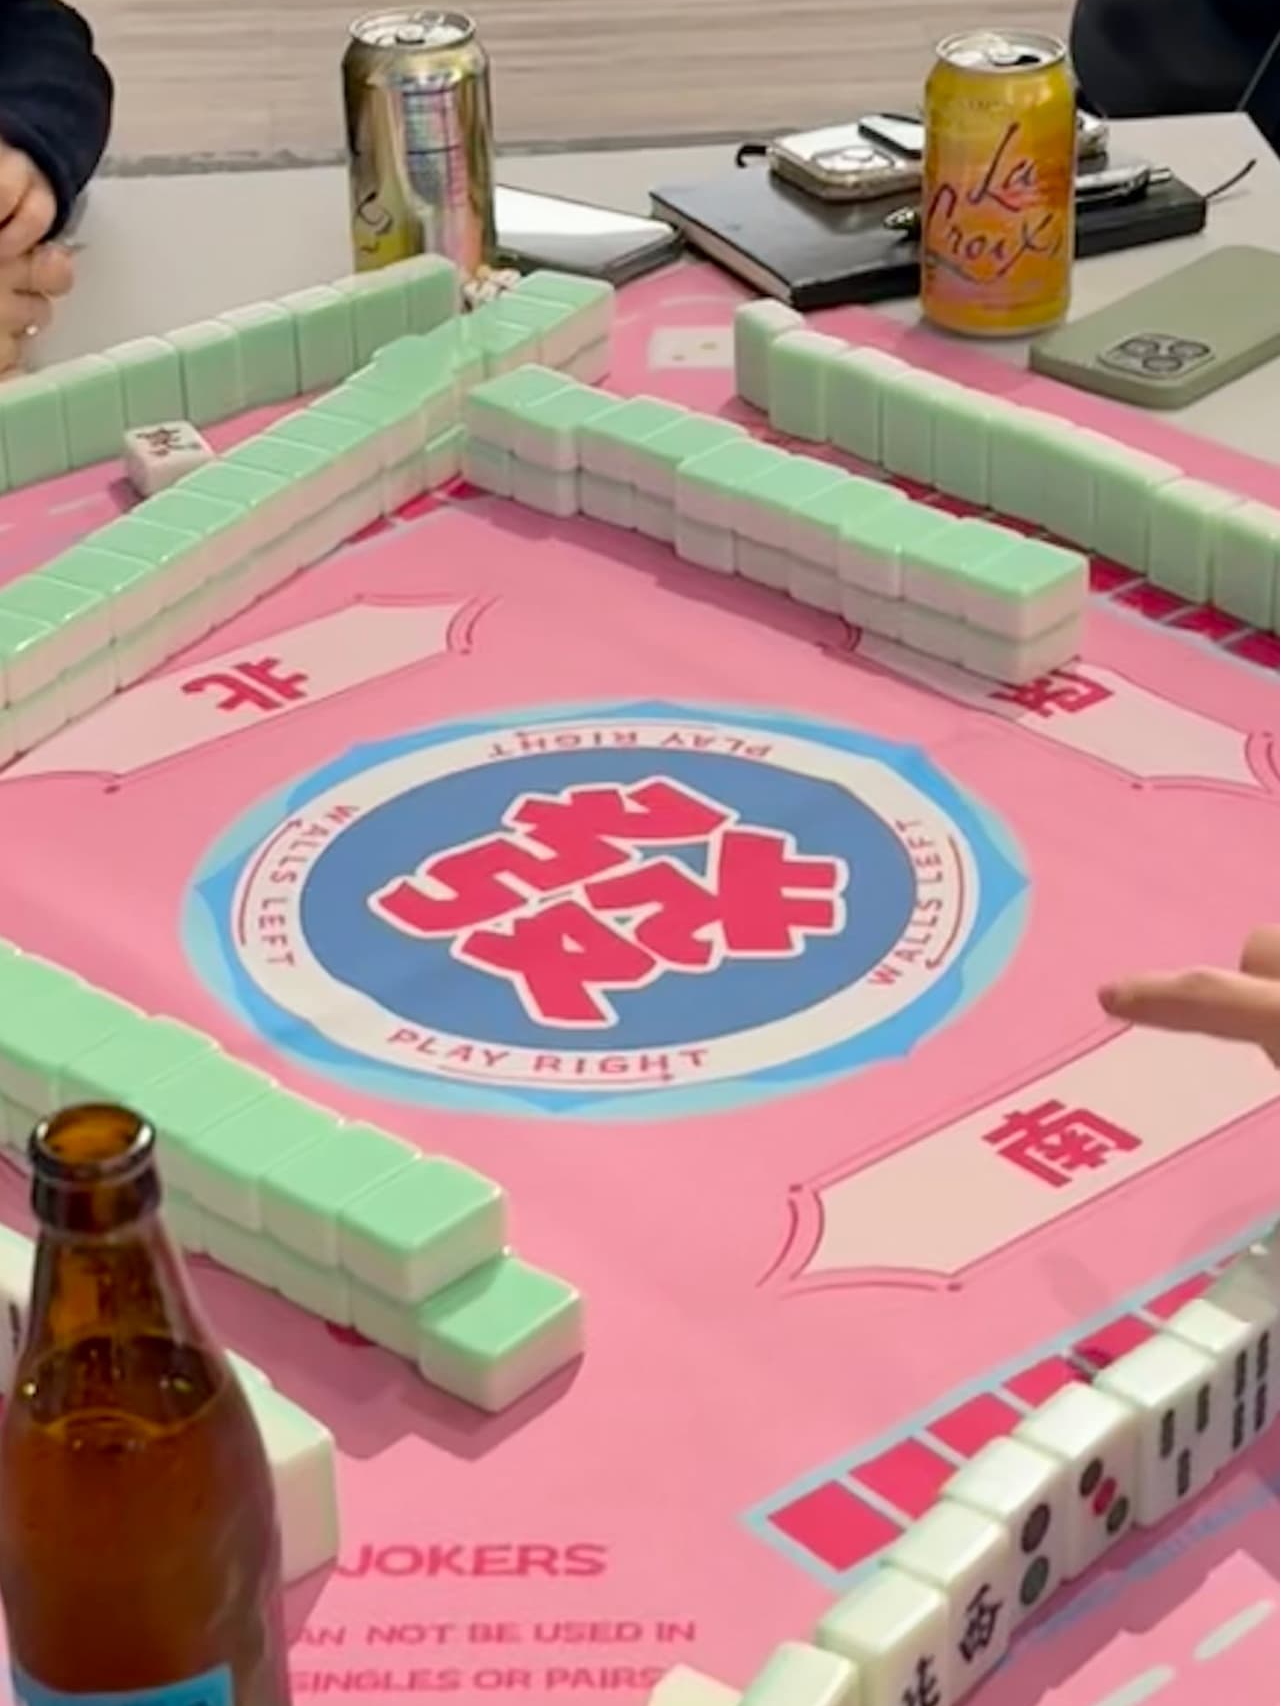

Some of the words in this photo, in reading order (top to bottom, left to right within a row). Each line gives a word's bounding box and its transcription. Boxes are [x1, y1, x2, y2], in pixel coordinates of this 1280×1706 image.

[968, 122, 1035, 212] La
[182, 657, 310, 712] 北
[488, 730, 639, 759] RIGHT
[660, 731, 772, 758] PLAY
[270, 804, 361, 885] WALLS
[895, 818, 944, 885] LEFT
[258, 895, 296, 967] LEFT
[866, 898, 944, 985] WALLS
[386, 1027, 510, 1067] PLAY
[532, 1047, 708, 1074] RIGHT
[980, 1098, 1144, 1189] 南
[337, 1543, 608, 1578] JOKERS
[288, 1624, 347, 1648] AN
[366, 1622, 457, 1647] NOT
[467, 1622, 519, 1645] BE
[533, 1620, 643, 1645] USED
[655, 1620, 697, 1644] IN
[958, 1582, 1004, 1664] 西
[288, 1668, 461, 1694] SINGLES
[472, 1668, 532, 1691] OR
[544, 1666, 666, 1691] PAIRS
